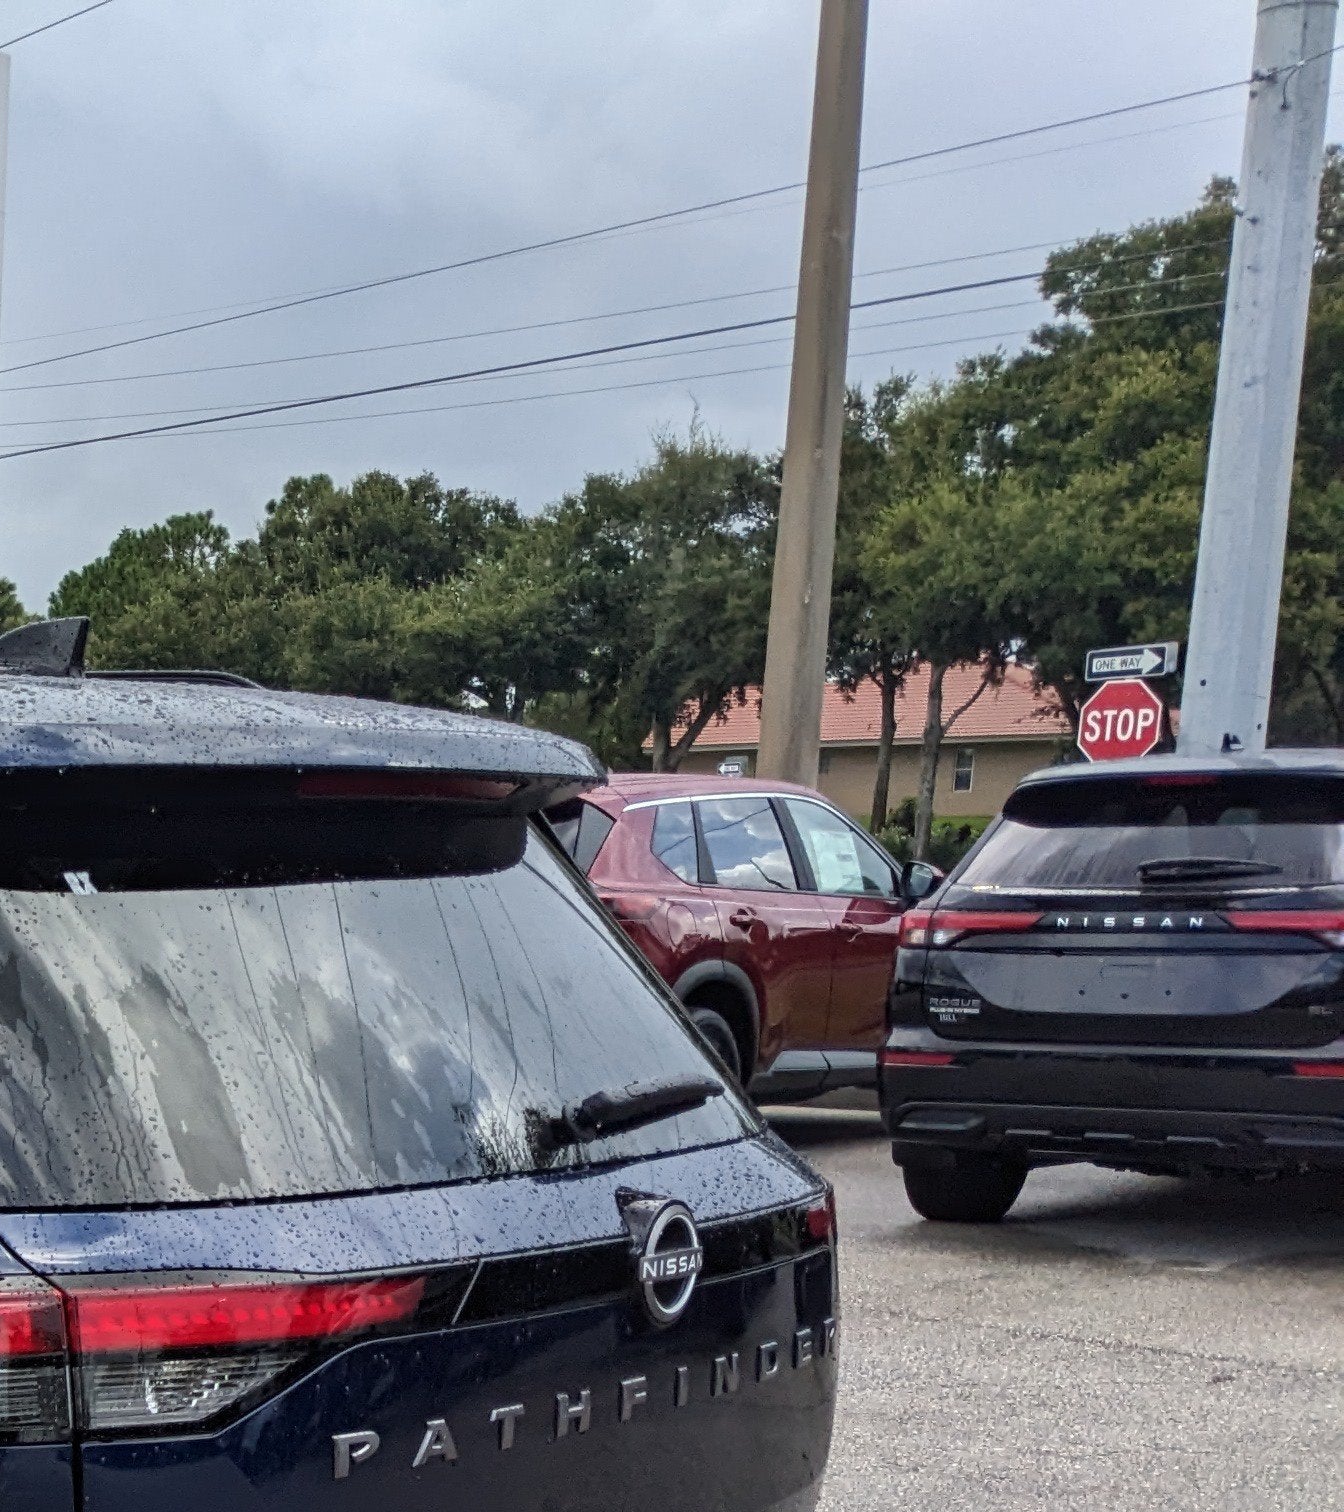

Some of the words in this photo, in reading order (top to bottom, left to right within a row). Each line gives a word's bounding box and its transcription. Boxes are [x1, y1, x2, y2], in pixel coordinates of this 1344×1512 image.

[1095, 658, 1116, 671] ONE
[1120, 657, 1141, 668] WAY
[1084, 708, 1155, 742] STOP
[1057, 916, 1204, 928] NISSAN
[929, 997, 981, 1008] ROGUE
[642, 1251, 703, 1279] NISSAN
[330, 1317, 836, 1479] PATHFINDER
